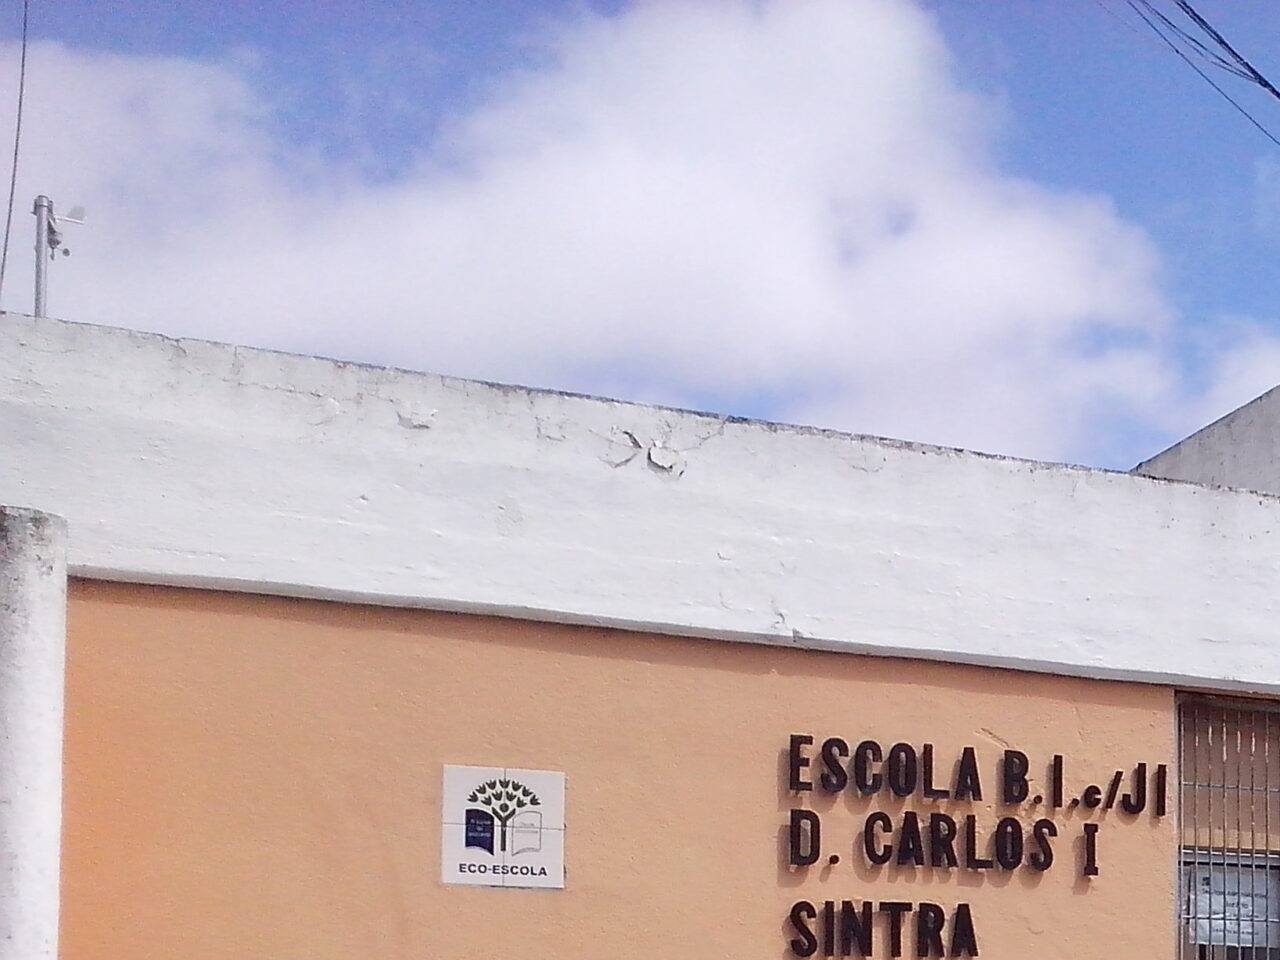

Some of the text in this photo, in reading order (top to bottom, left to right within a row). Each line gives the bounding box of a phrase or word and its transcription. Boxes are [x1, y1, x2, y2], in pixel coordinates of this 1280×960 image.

[788, 733, 983, 802] ESCOLA
[458, 863, 548, 877] ECO-ESCOLA
[789, 808, 1100, 877] D. CARLOS I
[789, 900, 979, 958] SINTRA
